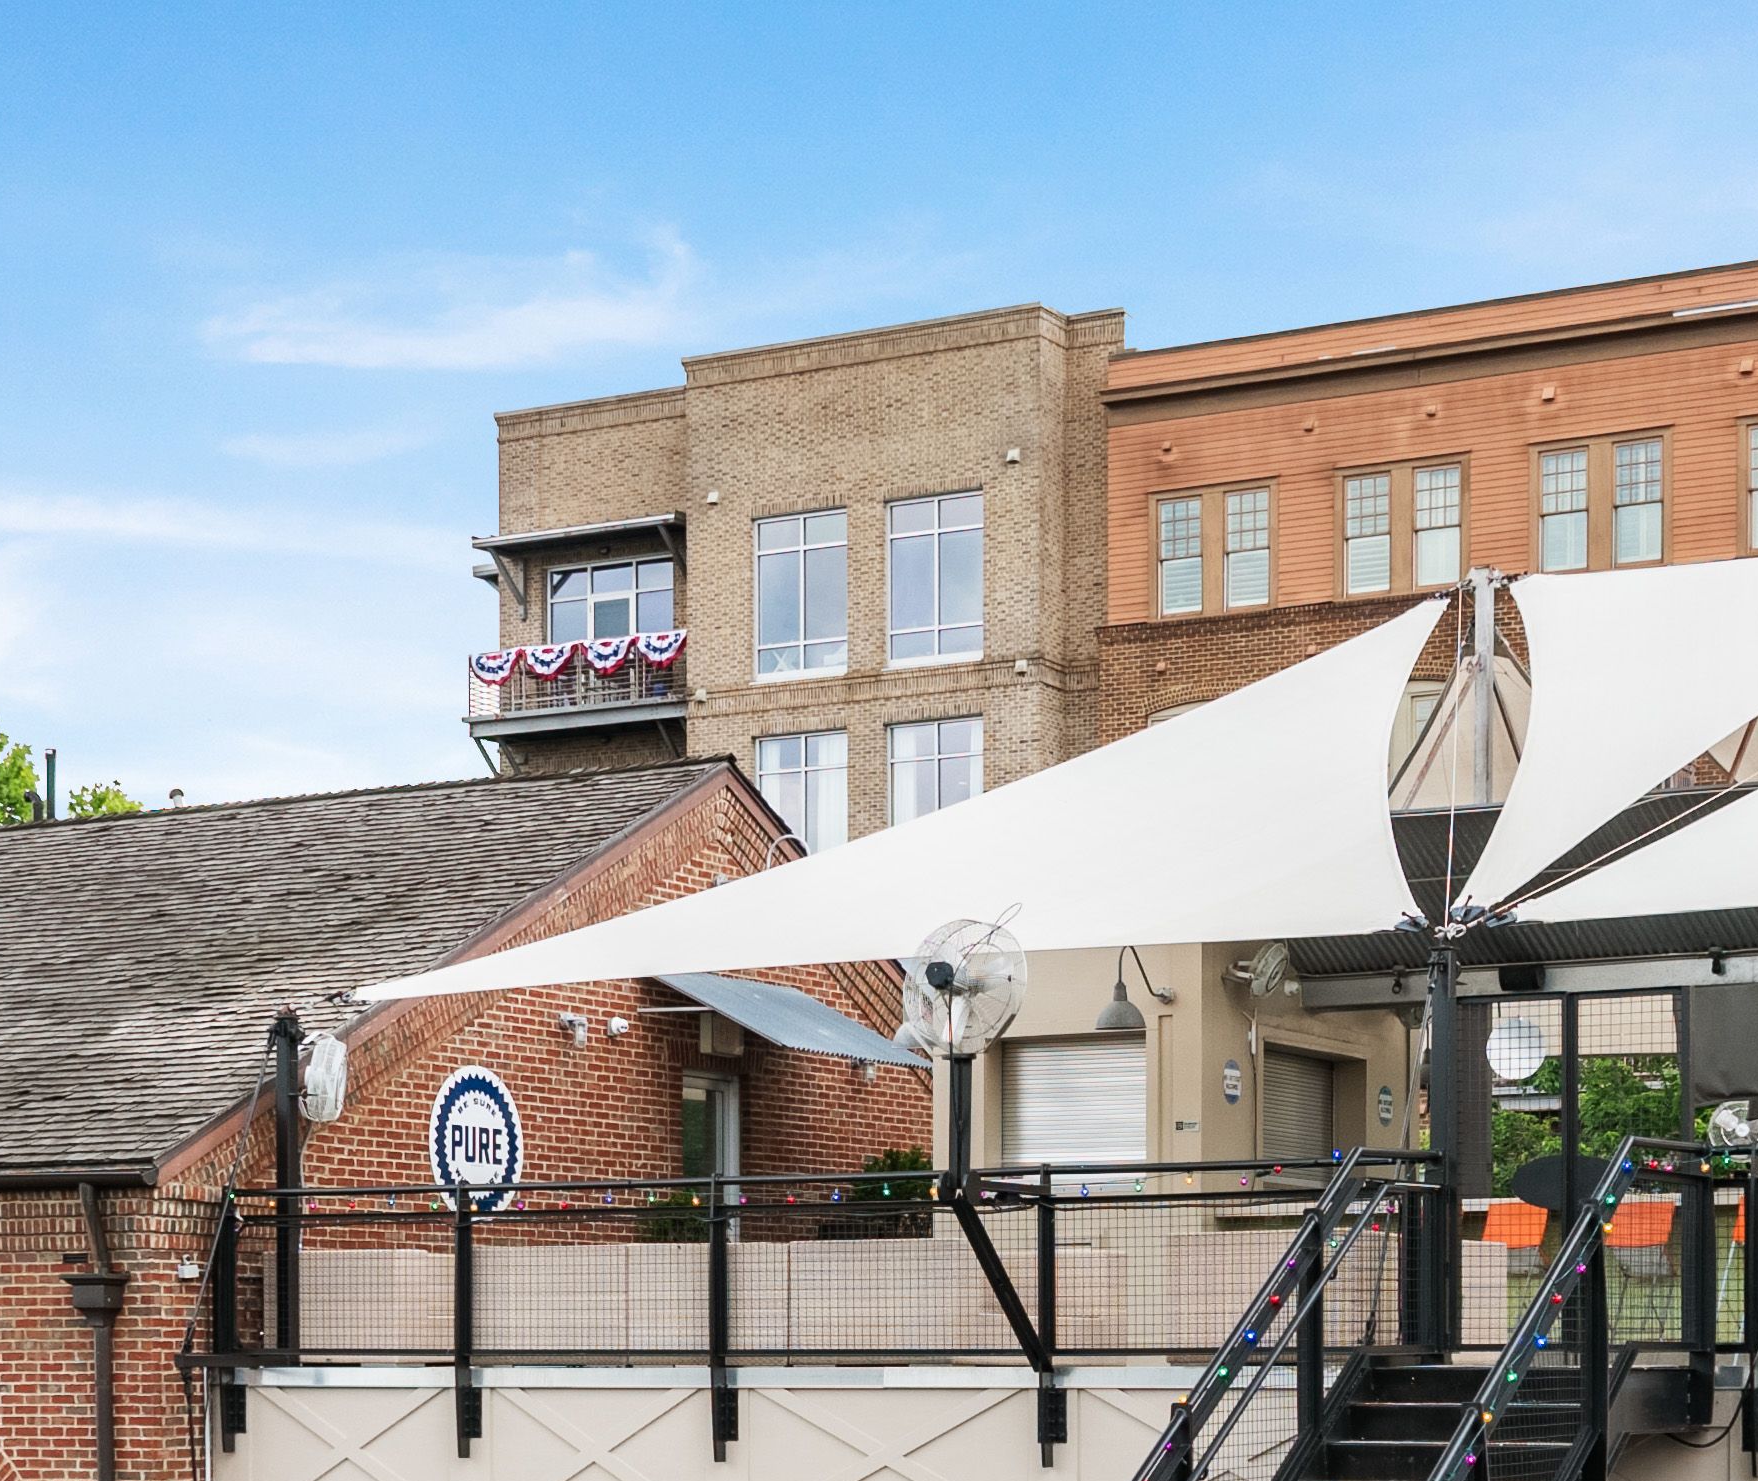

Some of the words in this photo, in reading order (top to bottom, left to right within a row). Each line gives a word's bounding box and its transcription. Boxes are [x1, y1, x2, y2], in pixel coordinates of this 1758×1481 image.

[457, 1101, 469, 1114] BE
[473, 1097, 497, 1116] SURE
[451, 1124, 502, 1165] PURE
